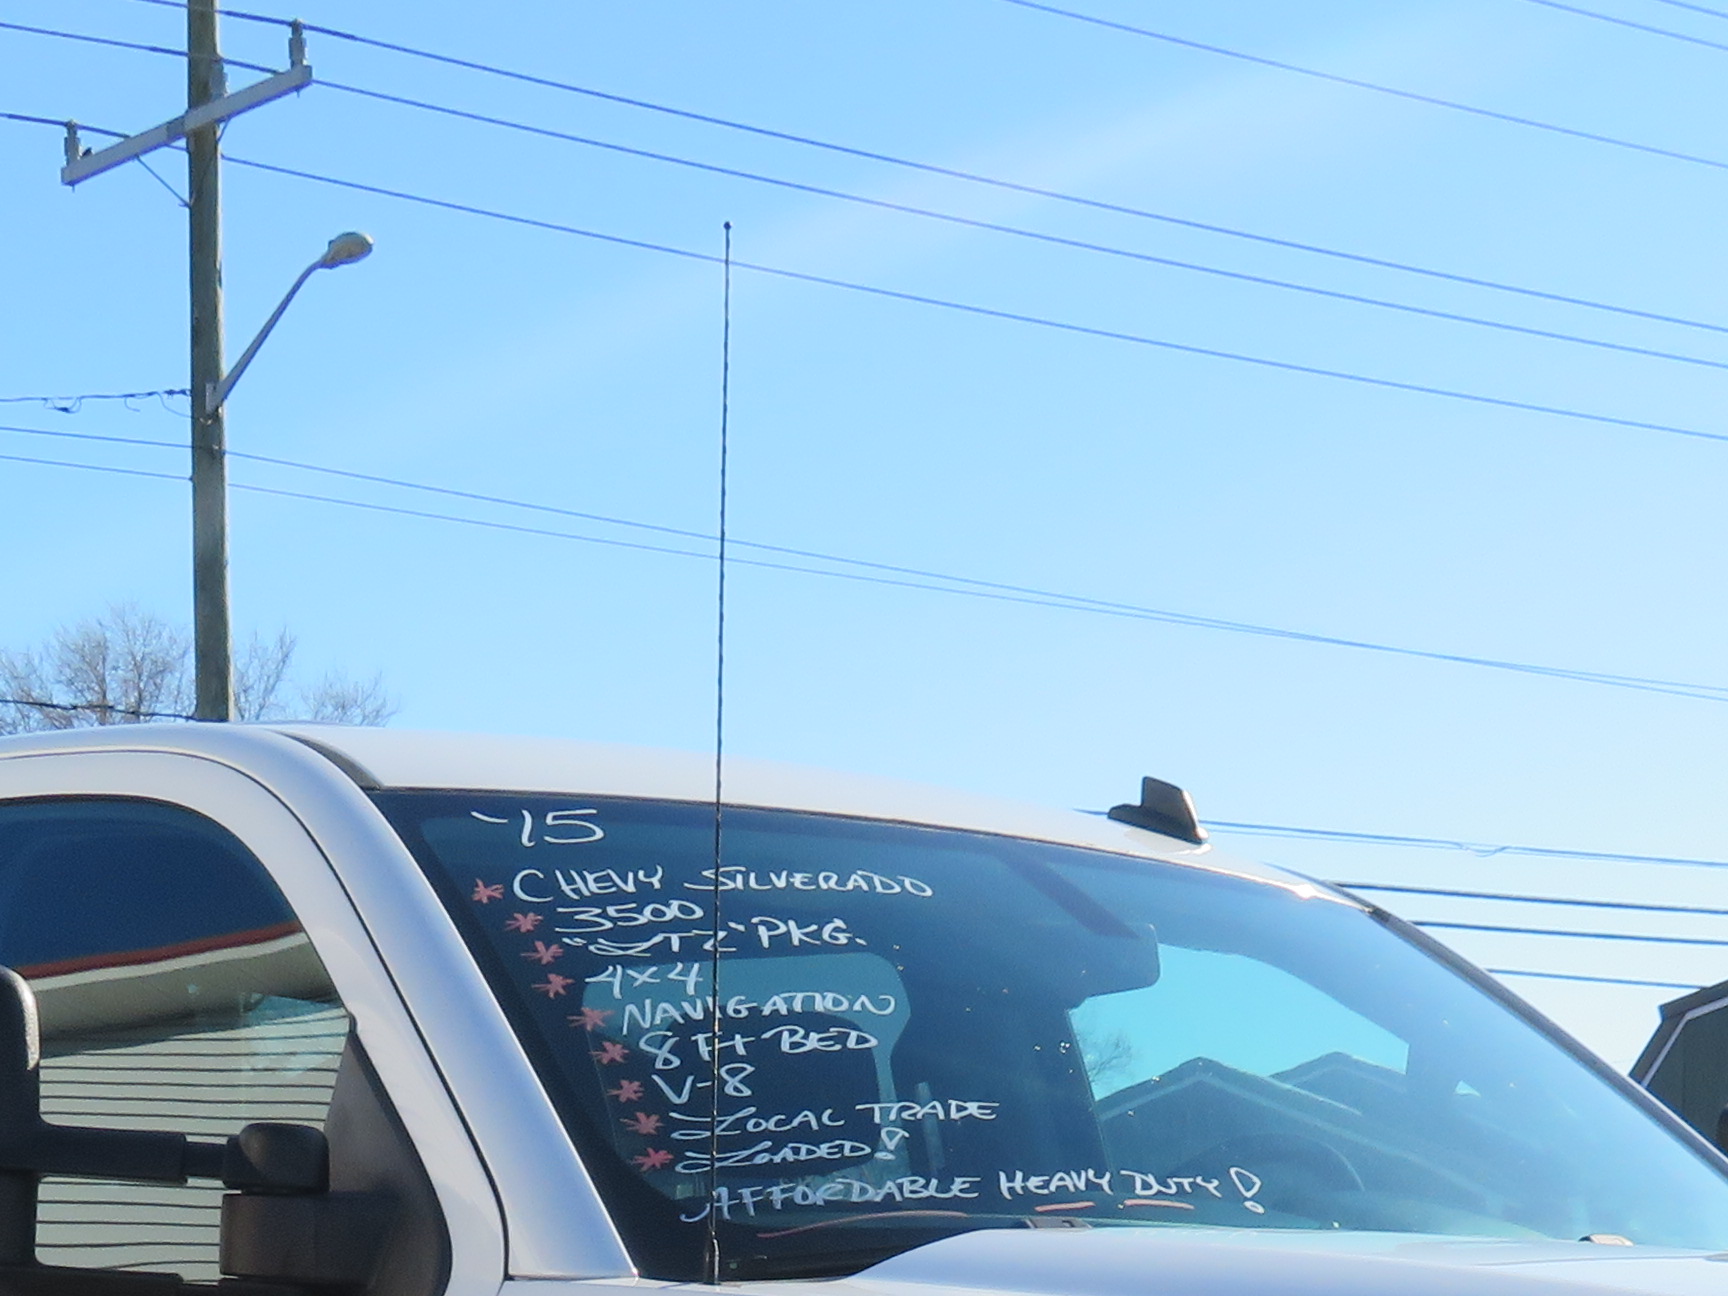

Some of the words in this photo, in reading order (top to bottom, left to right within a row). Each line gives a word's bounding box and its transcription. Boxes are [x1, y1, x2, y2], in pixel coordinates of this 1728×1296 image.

[512, 864, 664, 903] CHEVY
[683, 866, 934, 898] SILVERADO
[554, 899, 705, 933] 3500
[750, 915, 869, 950] PKG.
[622, 991, 897, 1036] NAVIGATION
[638, 1031, 681, 1070] 8
[761, 1025, 879, 1054] BED
[651, 1062, 757, 1104] V-8
[668, 1106, 846, 1140] LOCAL
[855, 1100, 1001, 1125] TRADE
[679, 1175, 982, 1223] AFFORDABLE
[998, 1167, 1114, 1200] HEAVY
